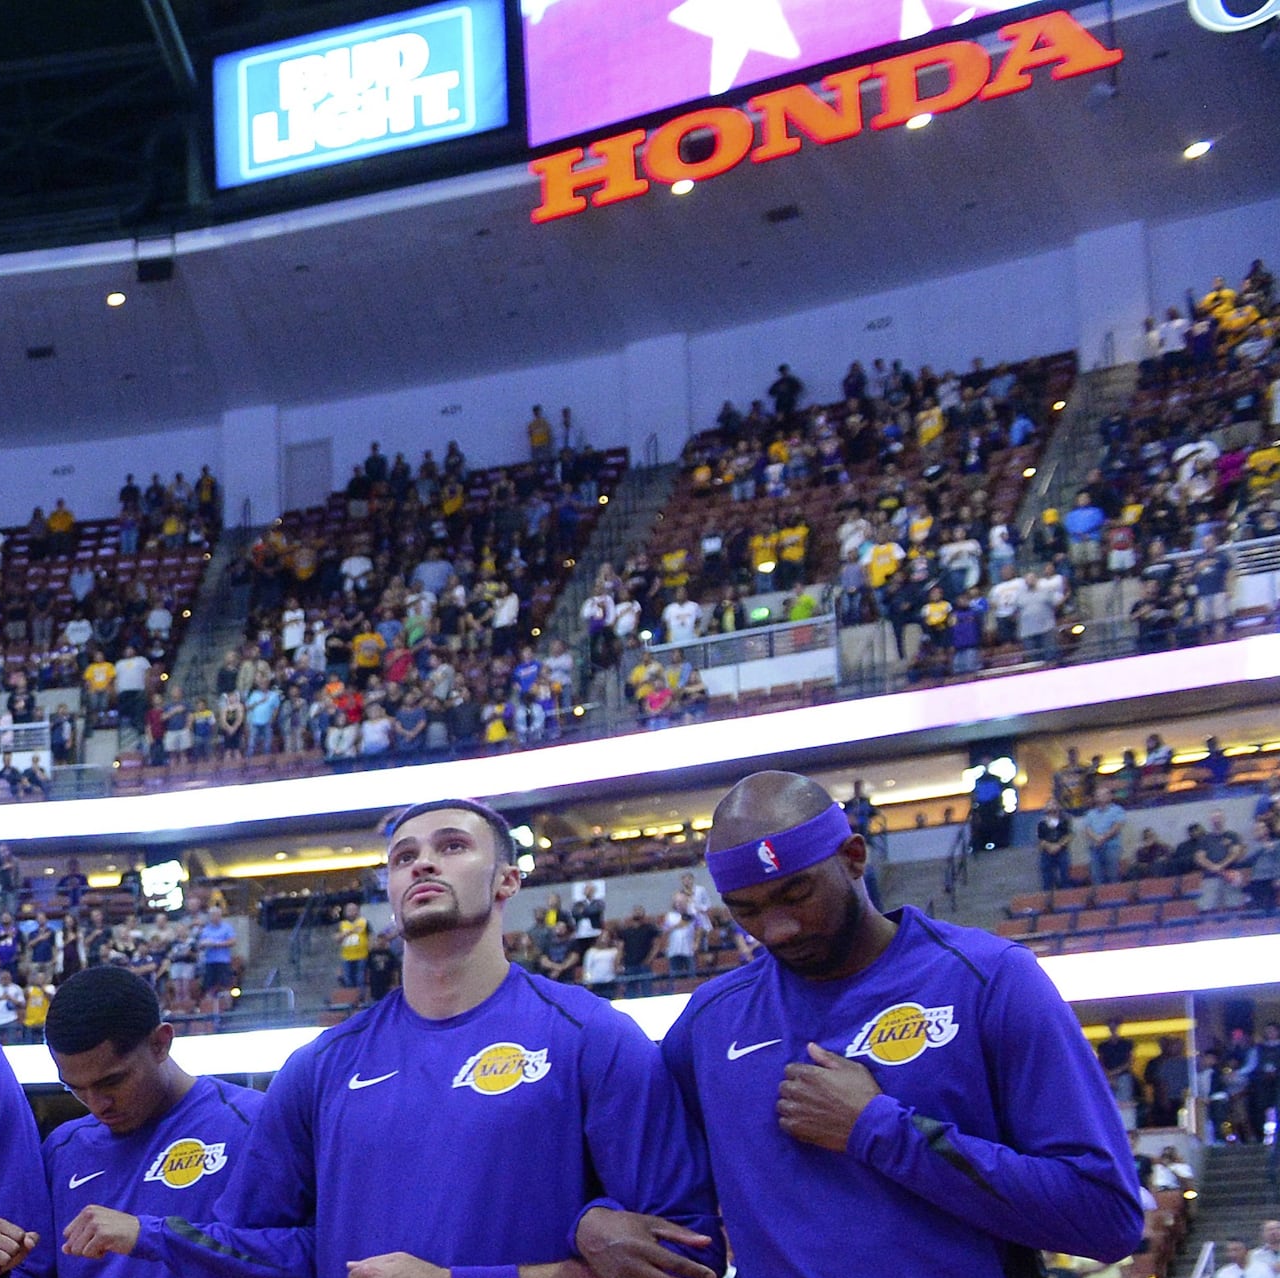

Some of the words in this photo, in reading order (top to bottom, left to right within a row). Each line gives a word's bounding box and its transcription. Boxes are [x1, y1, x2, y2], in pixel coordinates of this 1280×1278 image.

[278, 33, 430, 111] BUD
[530, 9, 1124, 224] HONDA
[855, 1018, 949, 1052] LAKERS
[461, 1058, 541, 1083] LAKERS
[153, 1151, 218, 1177] LAKERS
